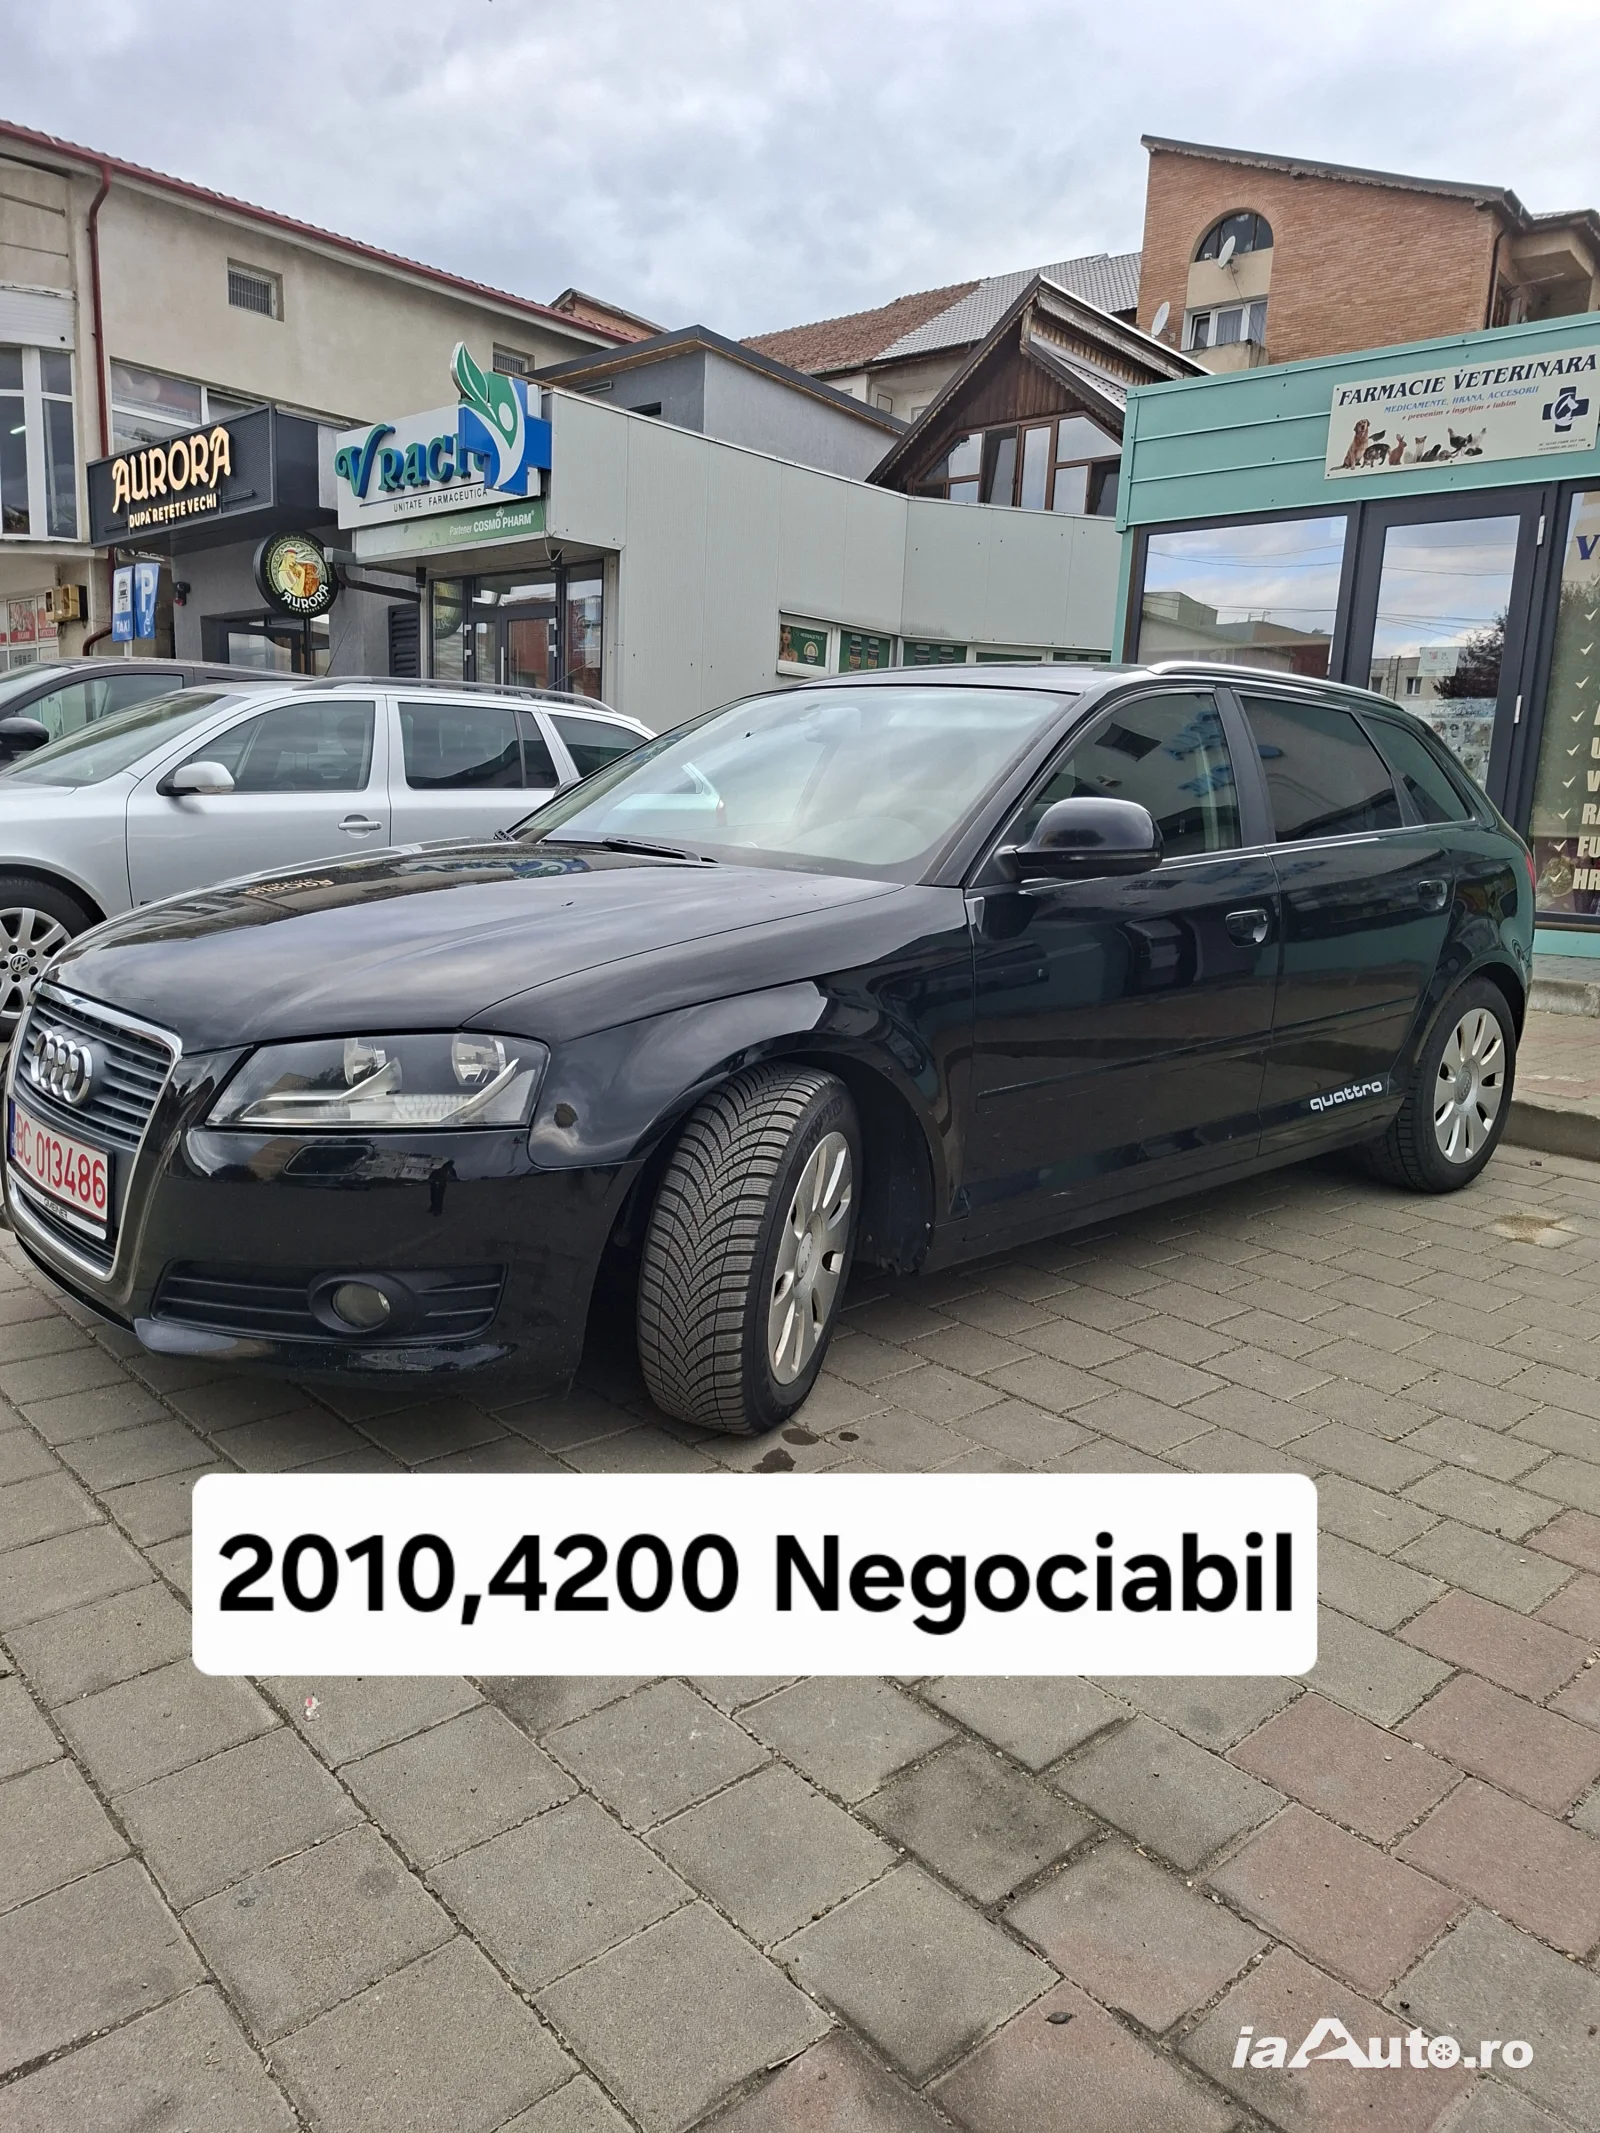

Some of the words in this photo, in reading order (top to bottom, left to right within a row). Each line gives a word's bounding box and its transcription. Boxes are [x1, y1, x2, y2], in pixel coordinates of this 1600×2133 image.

[1338, 376, 1446, 406] FARMACIE
[1453, 353, 1597, 391] VETERINARA
[1384, 398, 1449, 414] MEDICAMENTE,
[1452, 394, 1485, 404] HRANA,
[1488, 385, 1540, 400] ACCESORII
[1407, 408, 1444, 421] prevenim
[112, 426, 232, 514] AURORA
[187, 492, 217, 514] VECHI
[393, 499, 423, 513] UNITATE
[428, 487, 488, 507] FARMACEUTICA
[449, 526, 473, 537] Partener
[473, 518, 501, 533] COSMO
[1575, 534, 1600, 560] V
[141, 569, 153, 613] P
[281, 584, 329, 609] AURORA
[116, 619, 131, 633] TAXI
[1310, 1081, 1383, 1111] quattro
[16, 1111, 32, 1167] BC
[36, 1130, 106, 1209] 013486
